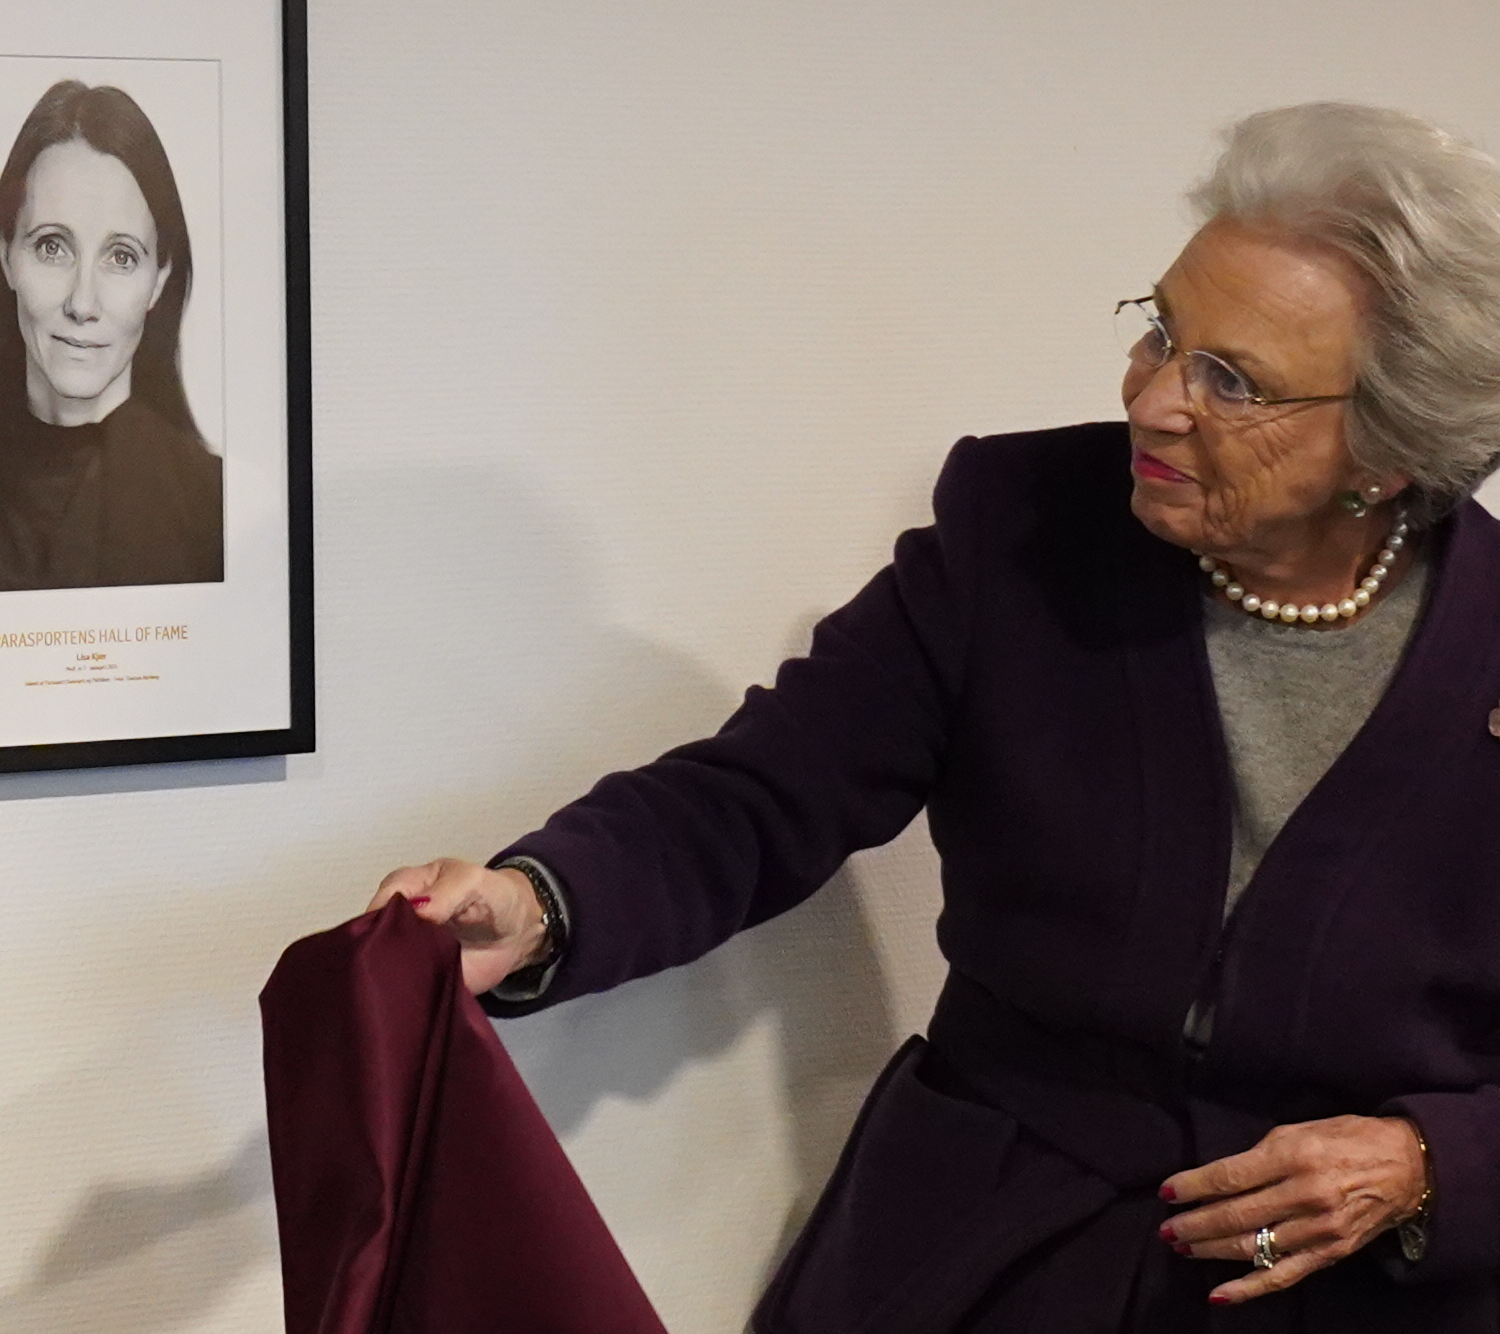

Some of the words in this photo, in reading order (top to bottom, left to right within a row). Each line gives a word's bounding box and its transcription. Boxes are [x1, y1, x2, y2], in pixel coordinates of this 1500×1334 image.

[99, 627, 131, 643] HALL
[135, 626, 152, 642] OF
[155, 625, 189, 641] FAME
